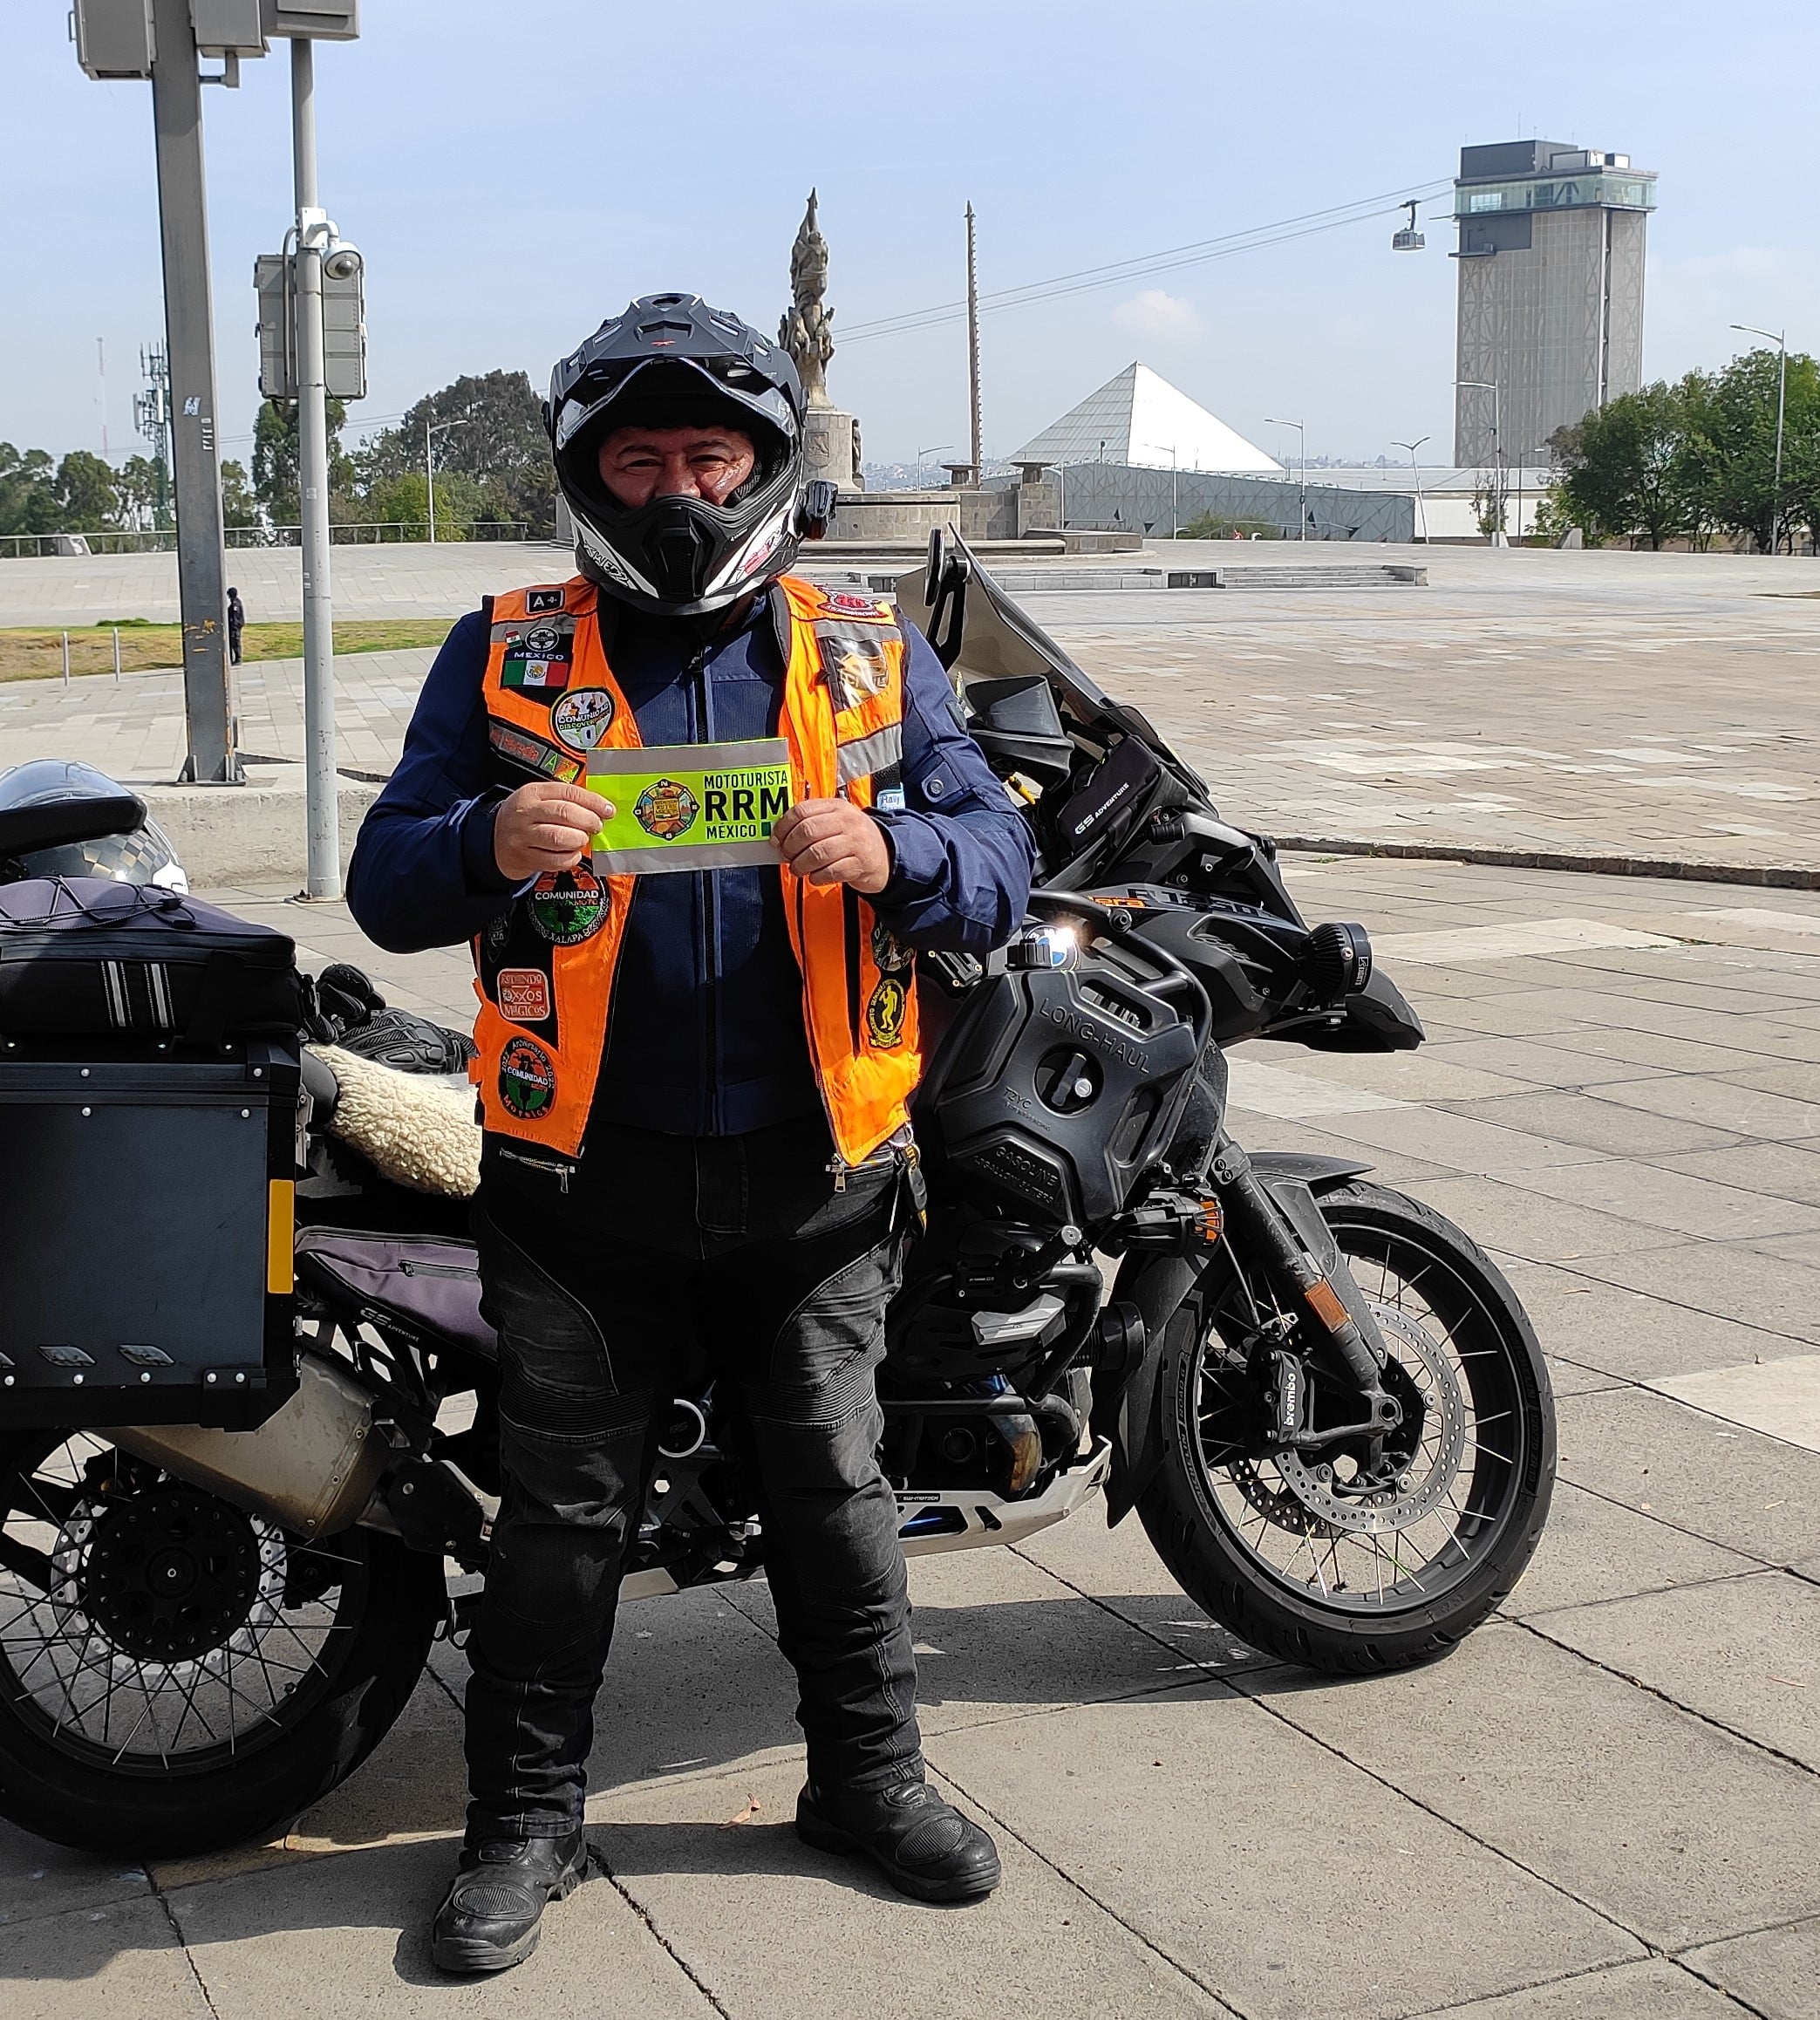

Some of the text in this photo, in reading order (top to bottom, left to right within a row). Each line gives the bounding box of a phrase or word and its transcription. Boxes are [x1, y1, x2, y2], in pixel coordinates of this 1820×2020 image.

[514, 652, 564, 660] MEXICO
[704, 770, 787, 789] MOTOTURISTA
[704, 786, 790, 822] RRM
[1074, 782, 1130, 835] GS ADVENTURE
[706, 822, 757, 839] MÉXICO
[535, 890, 599, 901] COMUNIDAD
[549, 932, 584, 944] XALAPA
[1039, 997, 1150, 1075] LONG-HAUL
[507, 1066, 549, 1086] COMUNIDAD
[995, 1146, 1059, 1187] GASOLINE
[387, 1324, 419, 1342] ADVENTURE
[1283, 1372, 1297, 1427] brembo
